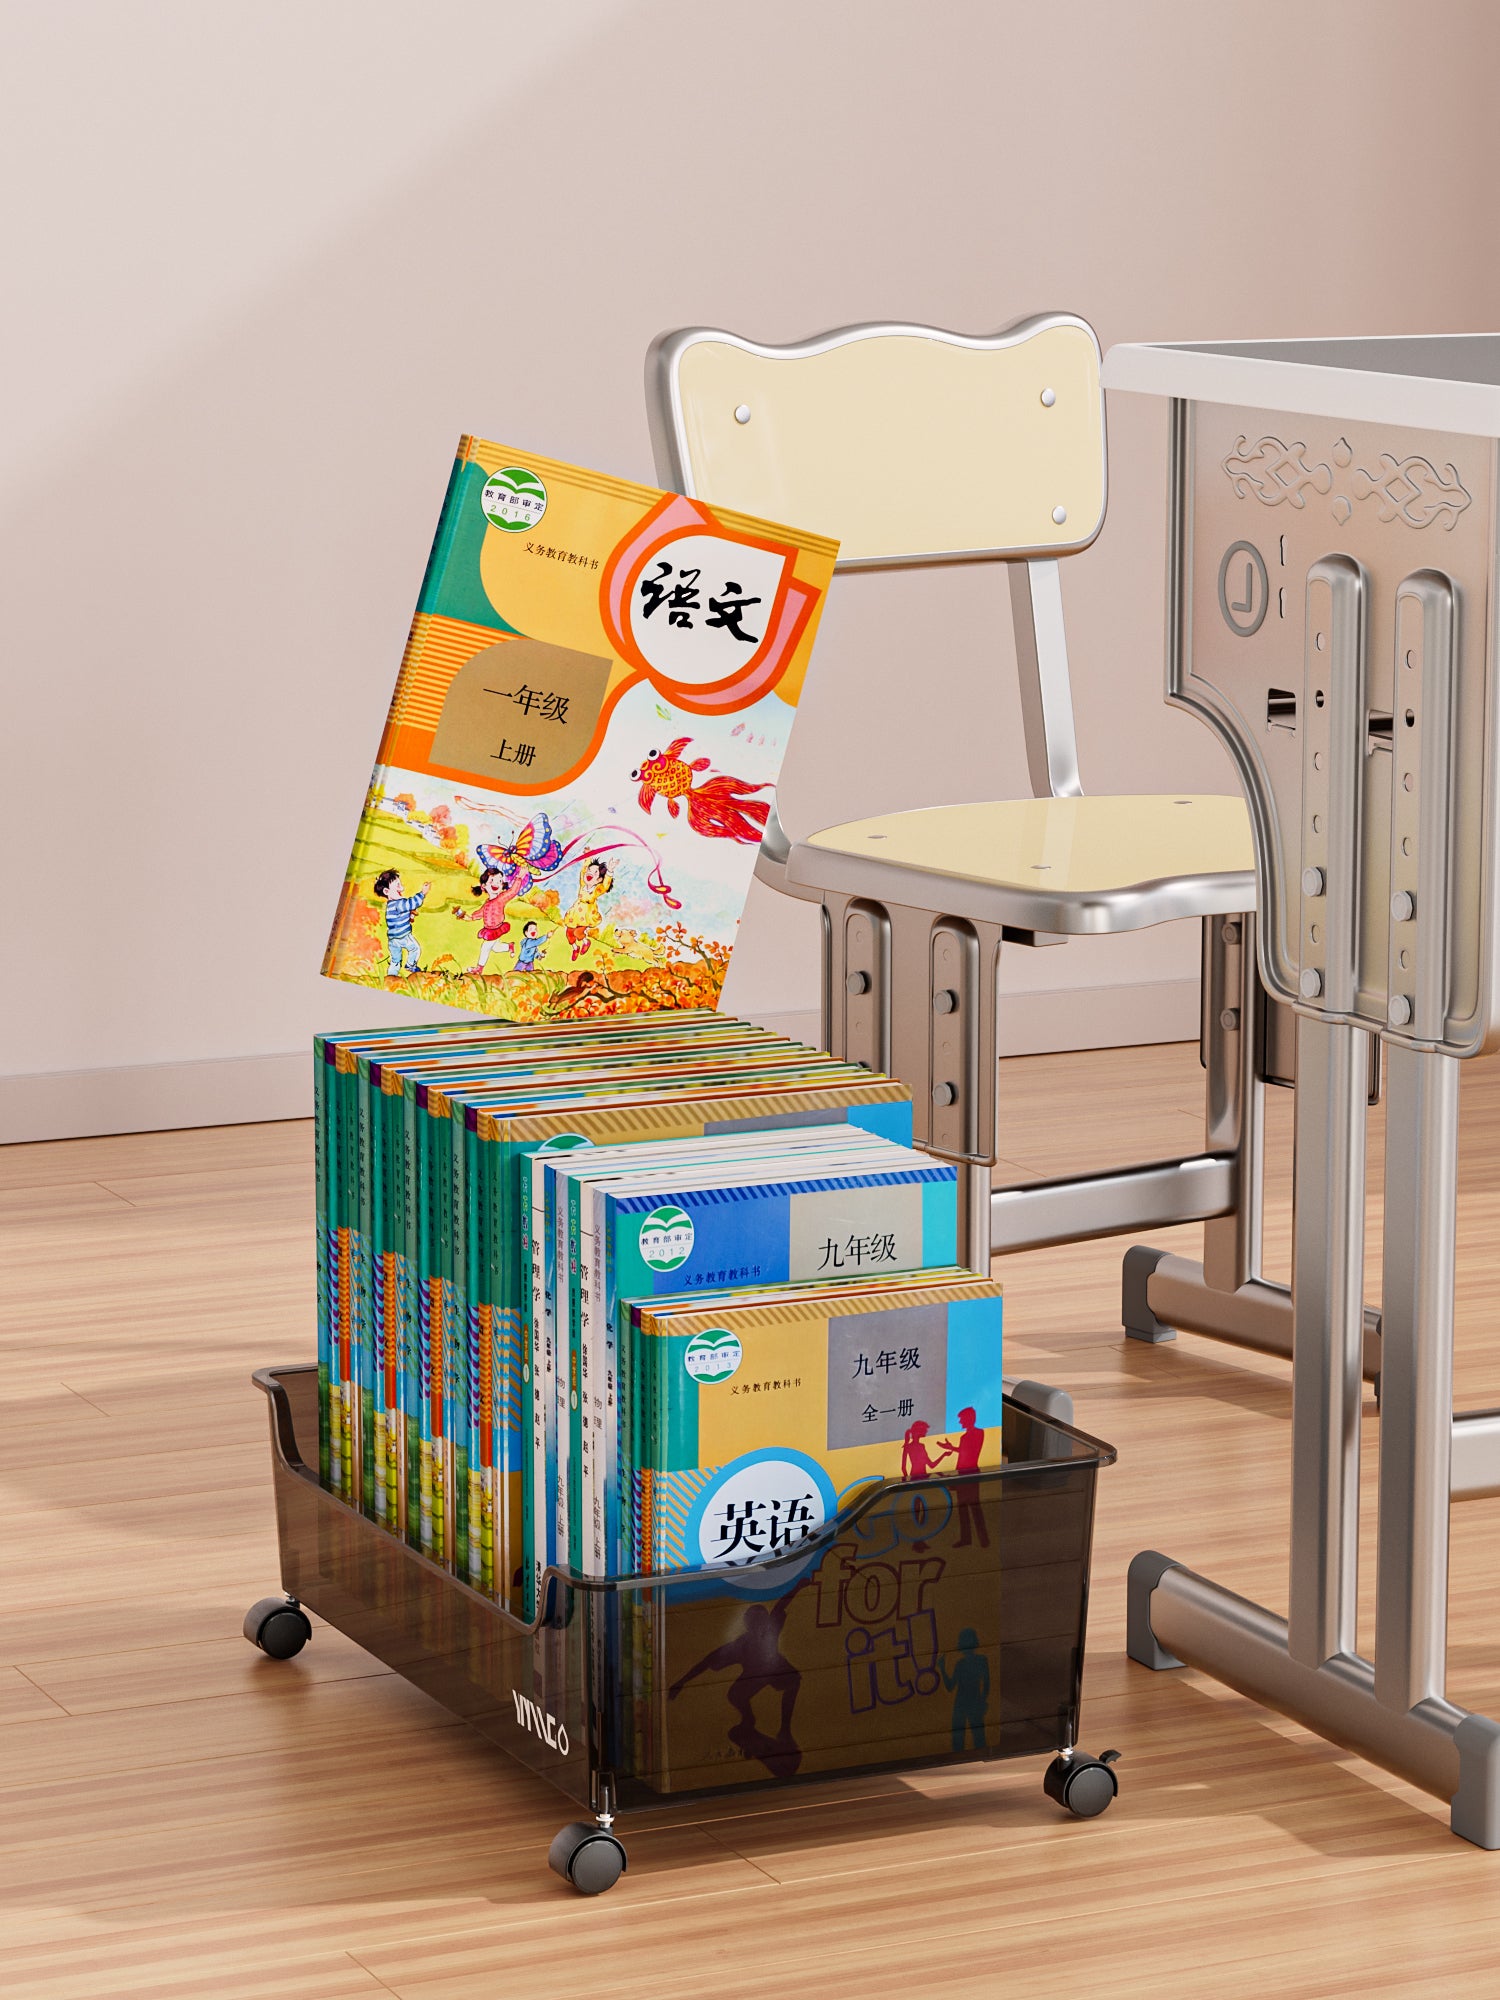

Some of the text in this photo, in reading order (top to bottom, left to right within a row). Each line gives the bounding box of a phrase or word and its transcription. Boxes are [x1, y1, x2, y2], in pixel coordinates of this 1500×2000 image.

[485, 489, 544, 512] 教育部审定
[490, 504, 531, 521] 2016
[523, 542, 599, 570] 义务教育教科书
[640, 561, 762, 644] 语文
[482, 684, 571, 725] 一年级
[489, 738, 537, 767] 上册
[649, 1247, 685, 1258] 2012
[816, 1233, 898, 1272] 九年级
[684, 1265, 762, 1287] 义务教育教科书
[852, 1347, 922, 1380] 九年级
[731, 1378, 802, 1396] 义务教育教科书
[861, 1398, 915, 1424] 全一册
[711, 1493, 815, 1560] 英语
[811, 1542, 947, 1628] for
[845, 1608, 942, 1715] it!
